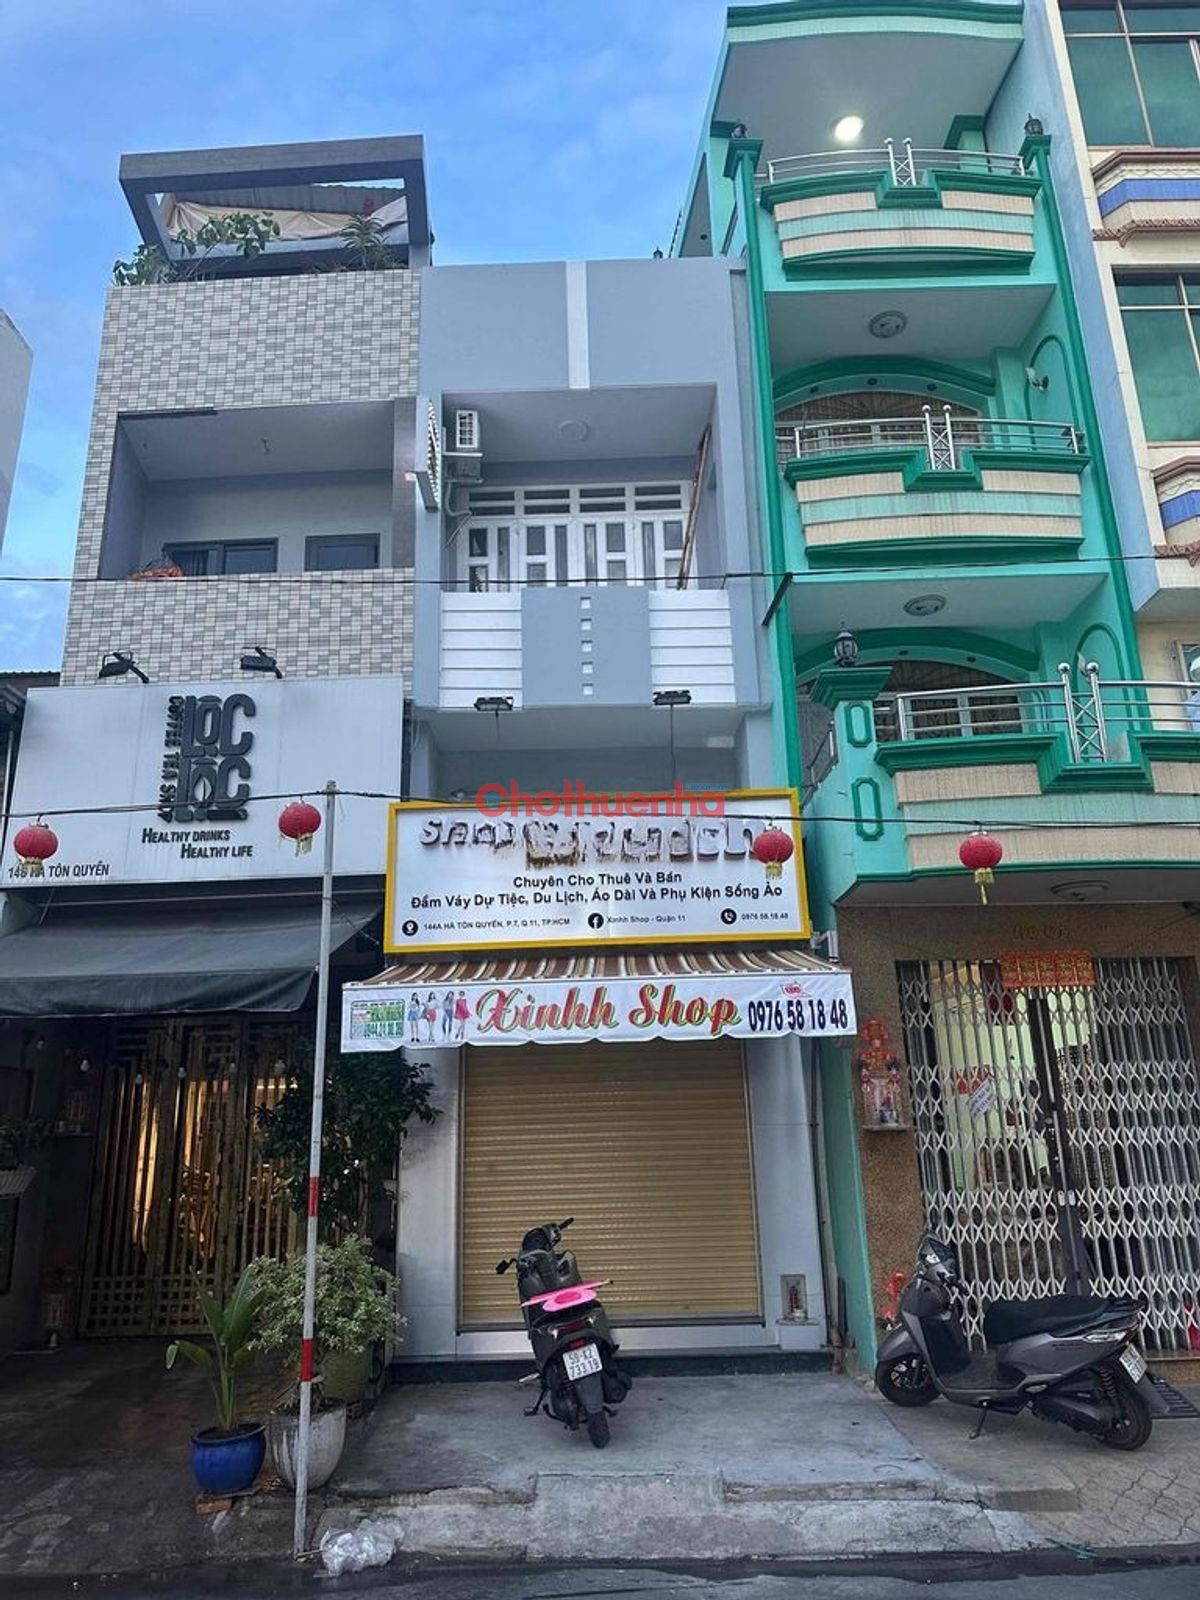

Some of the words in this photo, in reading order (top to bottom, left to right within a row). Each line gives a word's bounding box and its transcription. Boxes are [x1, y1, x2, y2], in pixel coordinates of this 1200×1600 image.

[161, 752, 180, 780] TEA
[231, 845, 254, 857] LIFE
[48, 863, 70, 878] TÔN
[513, 875, 564, 890] Chuyên
[567, 874, 595, 886] Cho
[598, 872, 631, 885] Thuê
[635, 871, 652, 883] Và
[656, 871, 682, 883] Bán
[445, 894, 471, 909] Váy
[474, 894, 495, 909] Dự
[533, 891, 551, 903] Du
[592, 886, 610, 901] Áo
[614, 887, 636, 900] Dài
[640, 887, 657, 900] Và
[661, 887, 686, 902] Phụ
[690, 886, 721, 901] Kiện
[725, 883, 759, 900] Sống
[630, 915, 649, 925] Shop
[476, 984, 619, 1034] Xinhh
[629, 983, 742, 1036] Shop
[748, 1000, 783, 1031] 0976
[787, 999, 805, 1030] 58
[808, 999, 826, 1030] 18
[830, 998, 848, 1029] 48
